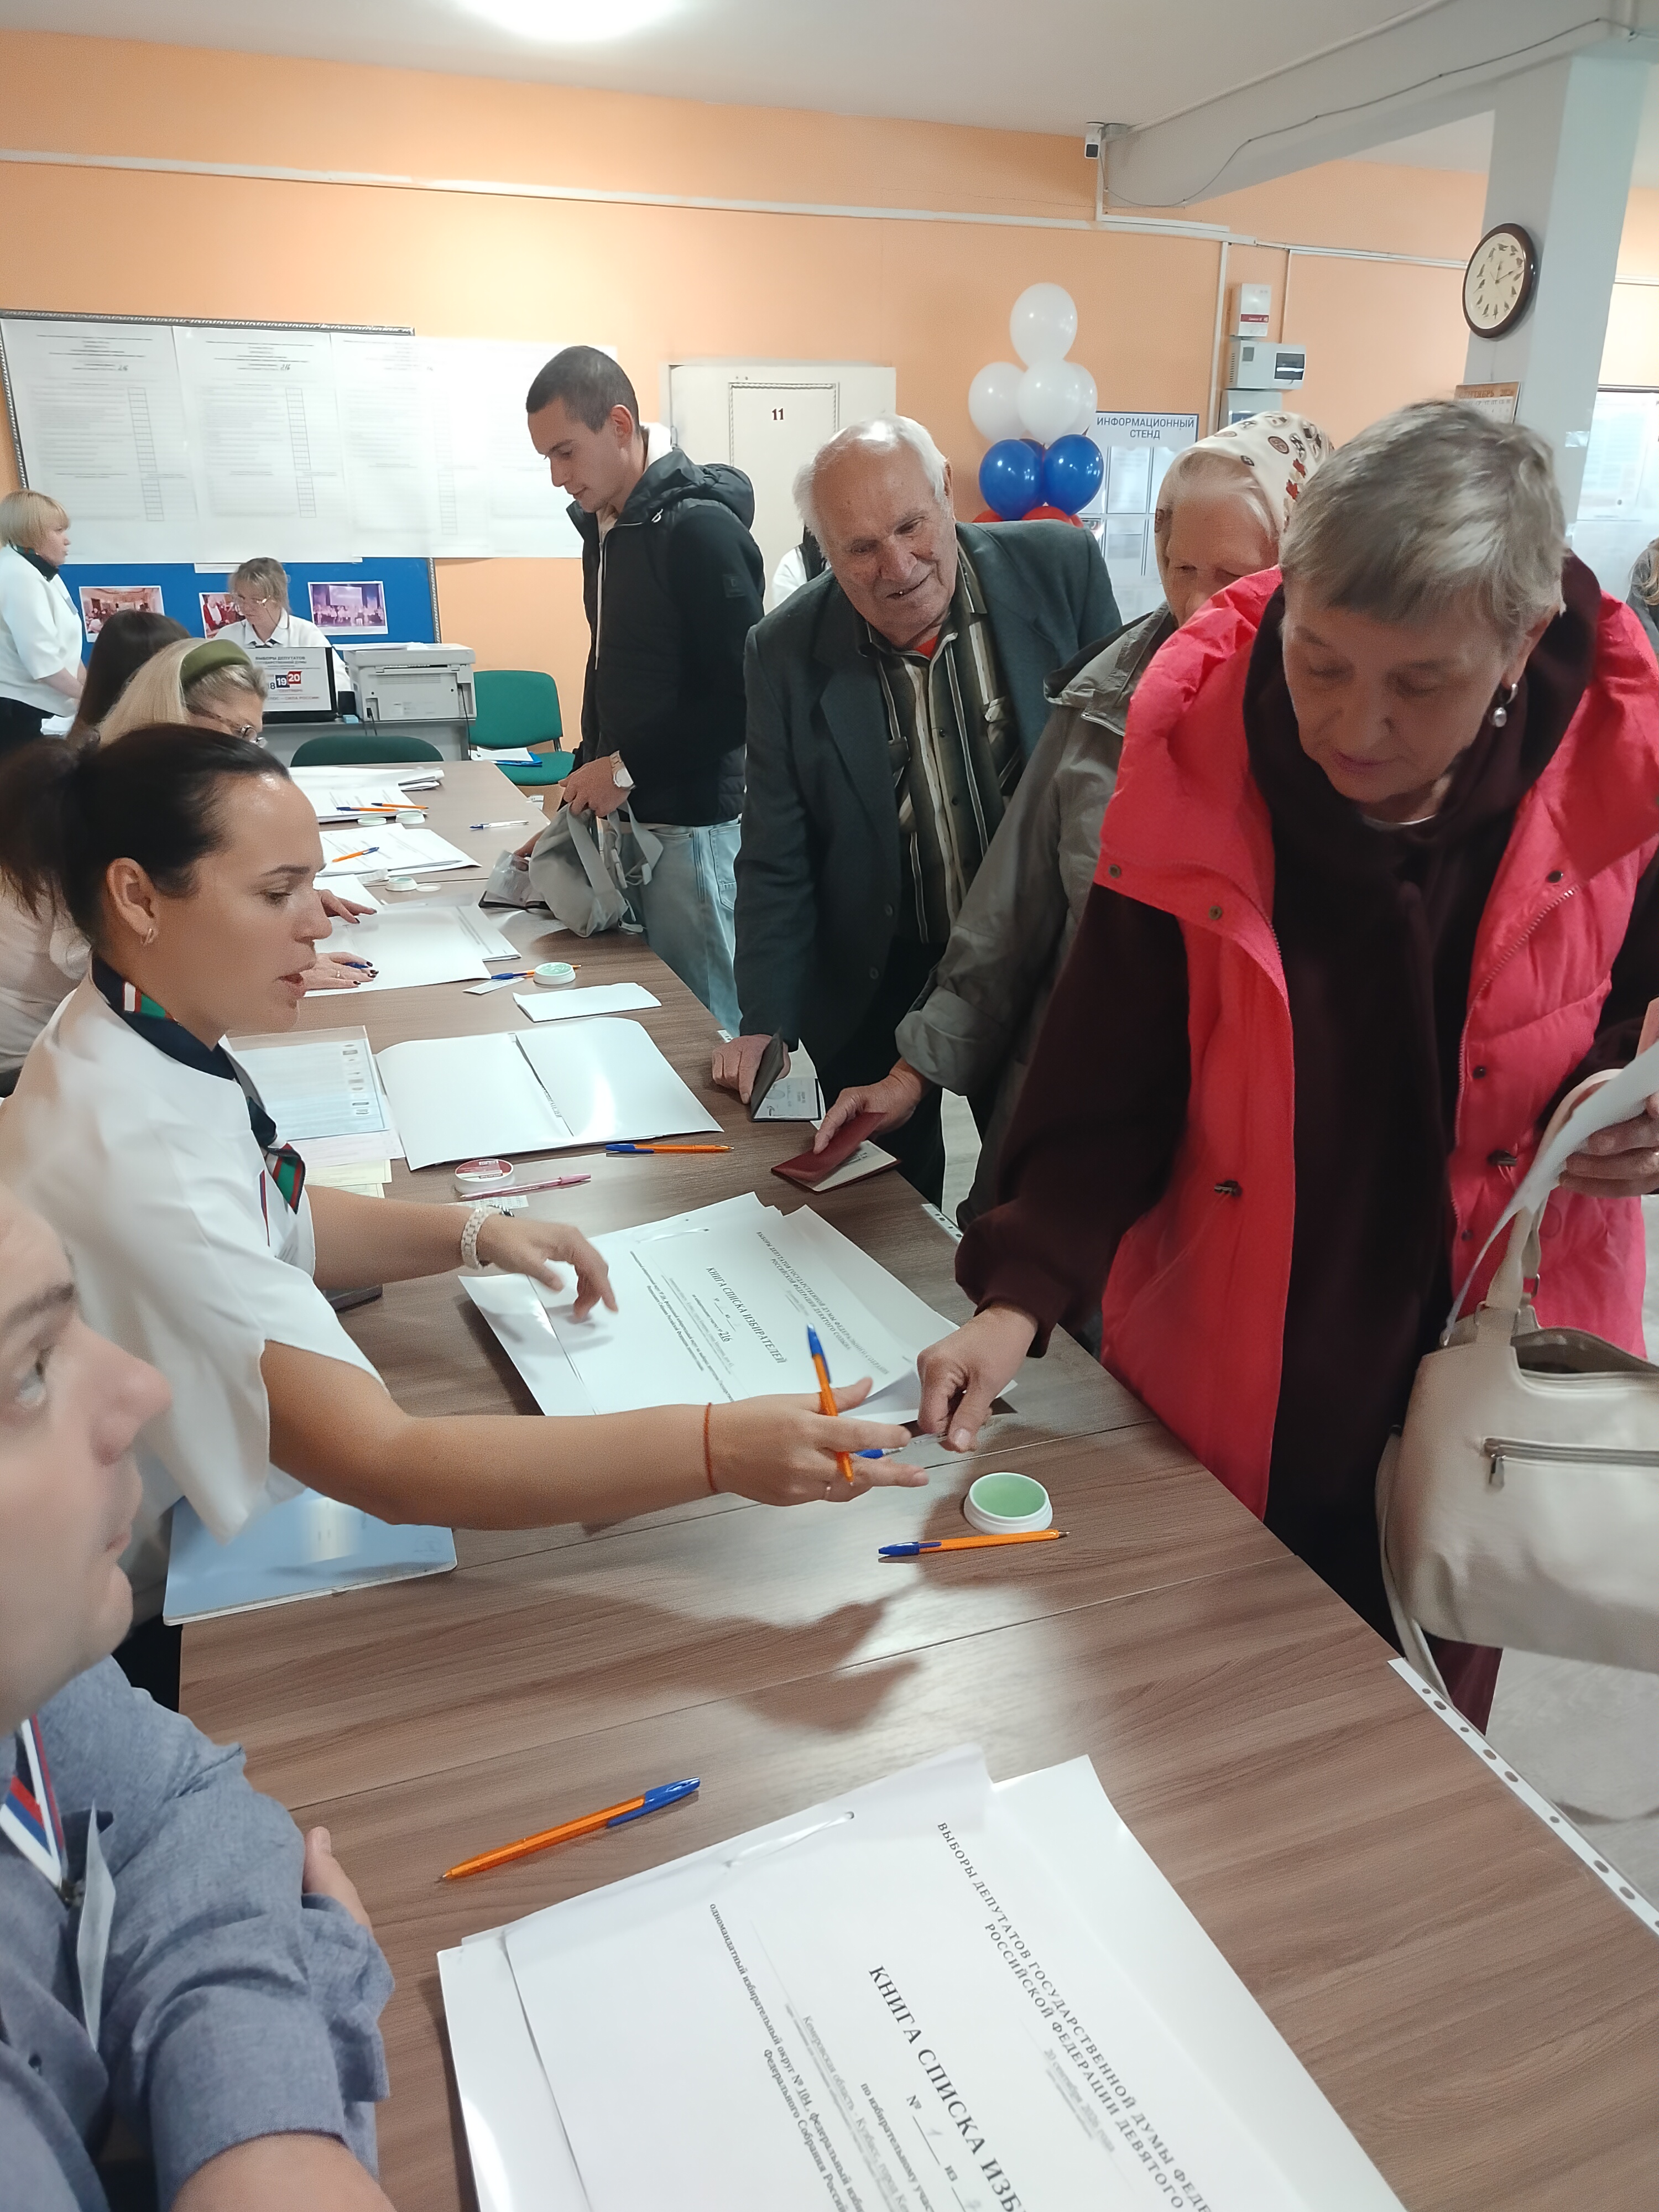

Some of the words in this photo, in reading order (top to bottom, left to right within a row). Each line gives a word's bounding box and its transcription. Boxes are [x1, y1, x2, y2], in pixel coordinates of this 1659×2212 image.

[772, 409, 784, 420] 11
[1097, 416, 1194, 428] ИНФОРМАЦИОННЫЙ
[1130, 430, 1160, 440] СТЕНД
[276, 677, 286, 686] 19
[288, 674, 300, 682] 20
[706, 1267, 727, 1287] КНИГА
[723, 1288, 748, 1313] СПИСКА
[742, 1314, 787, 1363] ИЗБИРАТЕЛЕЙ
[719, 1332, 733, 1342] 216
[710, 1904, 748, 1975] одномандатный
[743, 1976, 782, 2045] избирательный
[778, 2047, 795, 2073] округ
[792, 2075, 804, 2086] №
[938, 1823, 978, 1878] ВЫБОРЫ
[972, 1881, 1031, 1958] ДЕПУТАТОВ
[1029, 1962, 1136, 2109] ГОСУДАРСТВЕННОЙ
[1131, 2114, 1174, 2164] ДУМЫ
[860, 2083, 871, 2096] по
[869, 1966, 921, 2044] КНИГА
[919, 2049, 985, 2154] СПИСКА
[980, 2158, 1021, 2212] ИЗБ
[985, 1923, 1055, 2018] РОССИЙСКОЙ
[1052, 2022, 1119, 2115] ФЕДЕРАЦИИ
[1115, 2120, 1183, 2208] ДЕВЯТОГО
[764, 2049, 800, 2118] Федерального
[798, 2120, 826, 2172] Собрания
[907, 2095, 921, 2109] №
[945, 2166, 958, 2182] из
